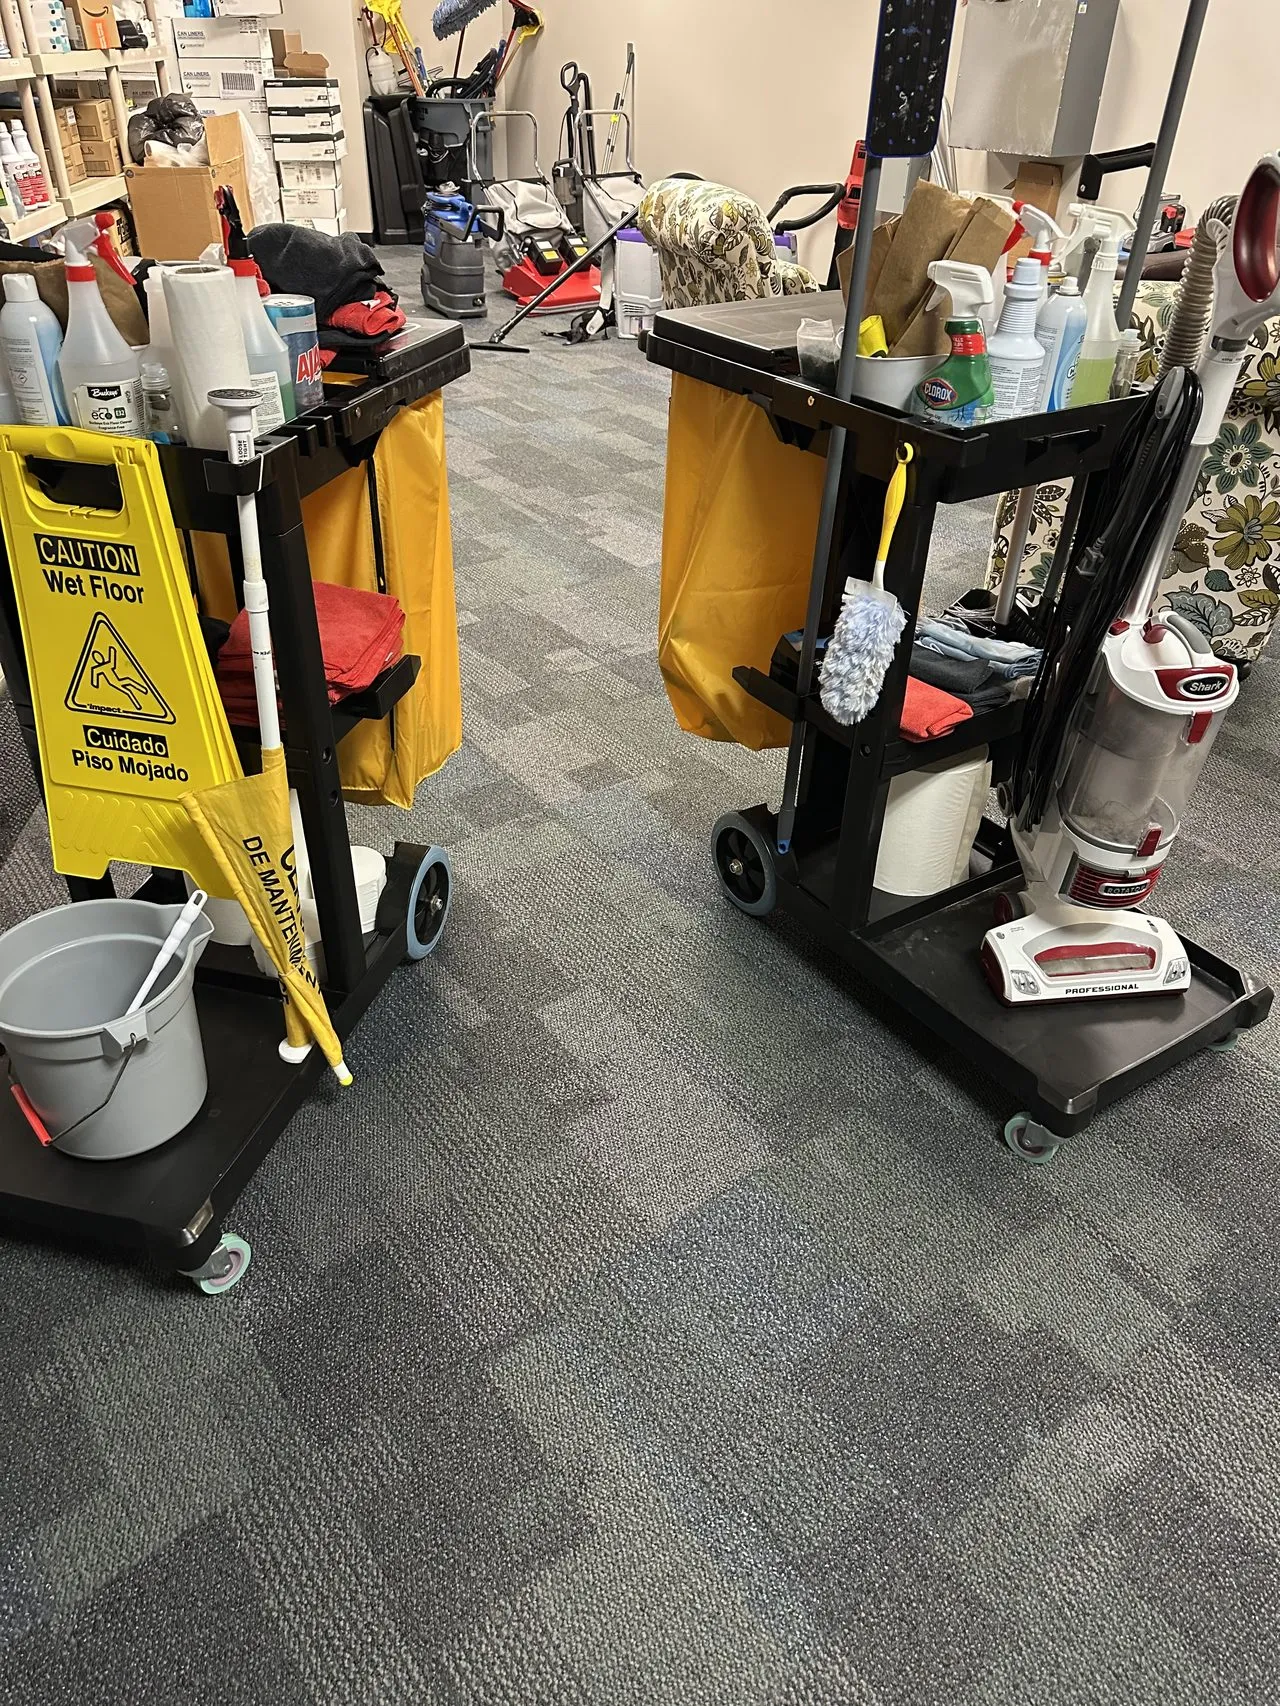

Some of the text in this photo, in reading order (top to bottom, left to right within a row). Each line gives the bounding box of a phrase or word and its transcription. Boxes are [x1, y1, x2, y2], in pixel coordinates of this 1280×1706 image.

[91, 388, 118, 397] Buckeye
[924, 383, 952, 401] CLOROX
[40, 538, 137, 573] CAUTION
[42, 569, 144, 604] Wet Floor
[1190, 681, 1222, 692] Shark
[87, 728, 166, 755] Cuidado
[72, 749, 189, 781] Piso Mojado
[243, 836, 270, 867] DE
[1065, 984, 1139, 995] PROFESSIONAL
